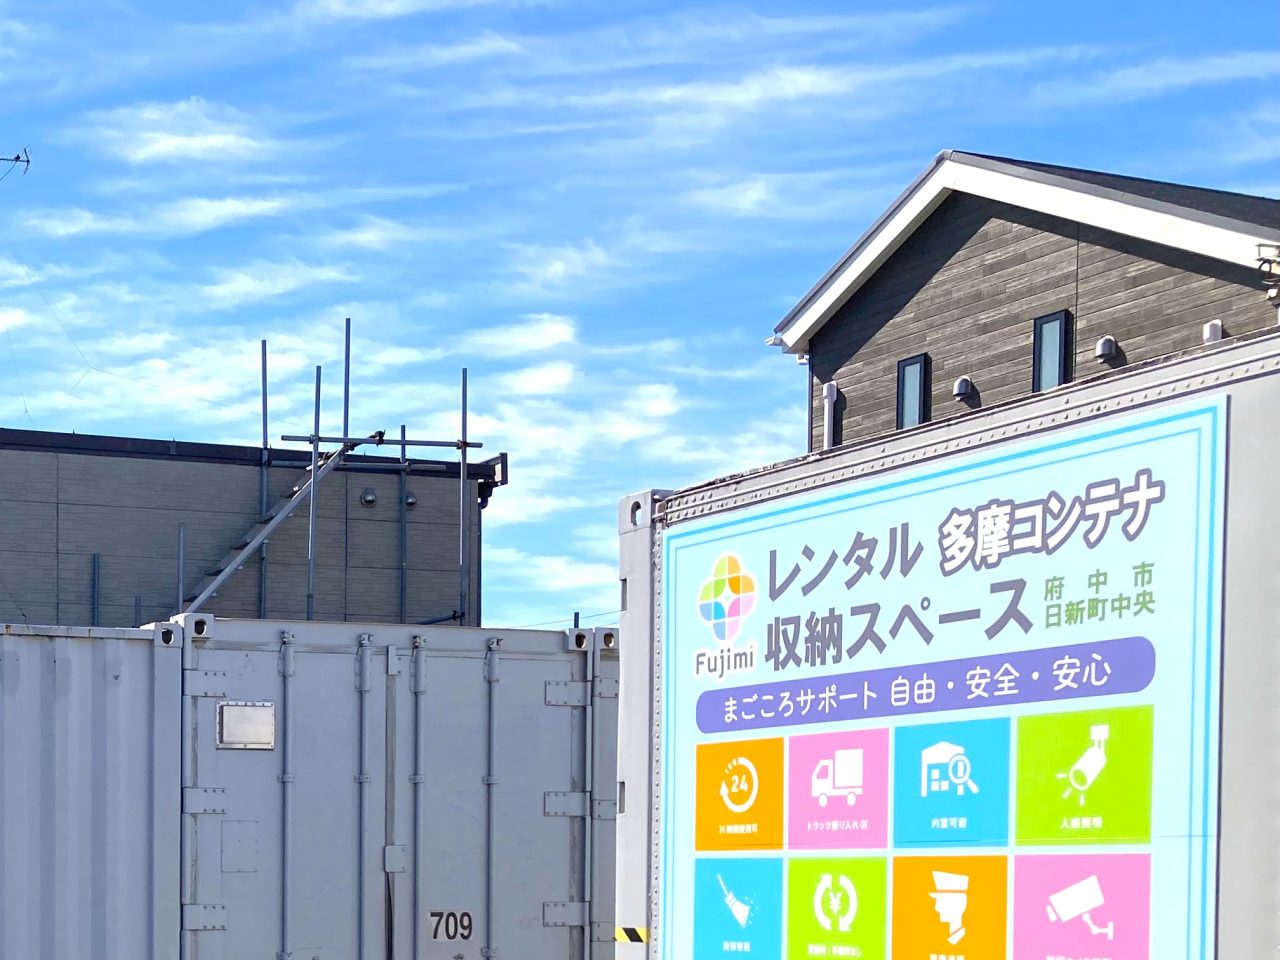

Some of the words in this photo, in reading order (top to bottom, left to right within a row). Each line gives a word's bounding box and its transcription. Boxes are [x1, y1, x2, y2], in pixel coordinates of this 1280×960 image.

[767, 521, 923, 603] レンタル
[937, 468, 1165, 576] 多摩コンテナ
[764, 577, 1034, 672] 収納スペース
[1045, 589, 1156, 629] 日新町中央
[695, 644, 754, 679] Fujimi
[724, 681, 878, 723] まごころサポート
[890, 652, 1112, 707] 自由・安全・安心
[731, 774, 749, 793] 24
[430, 911, 473, 940] 709
